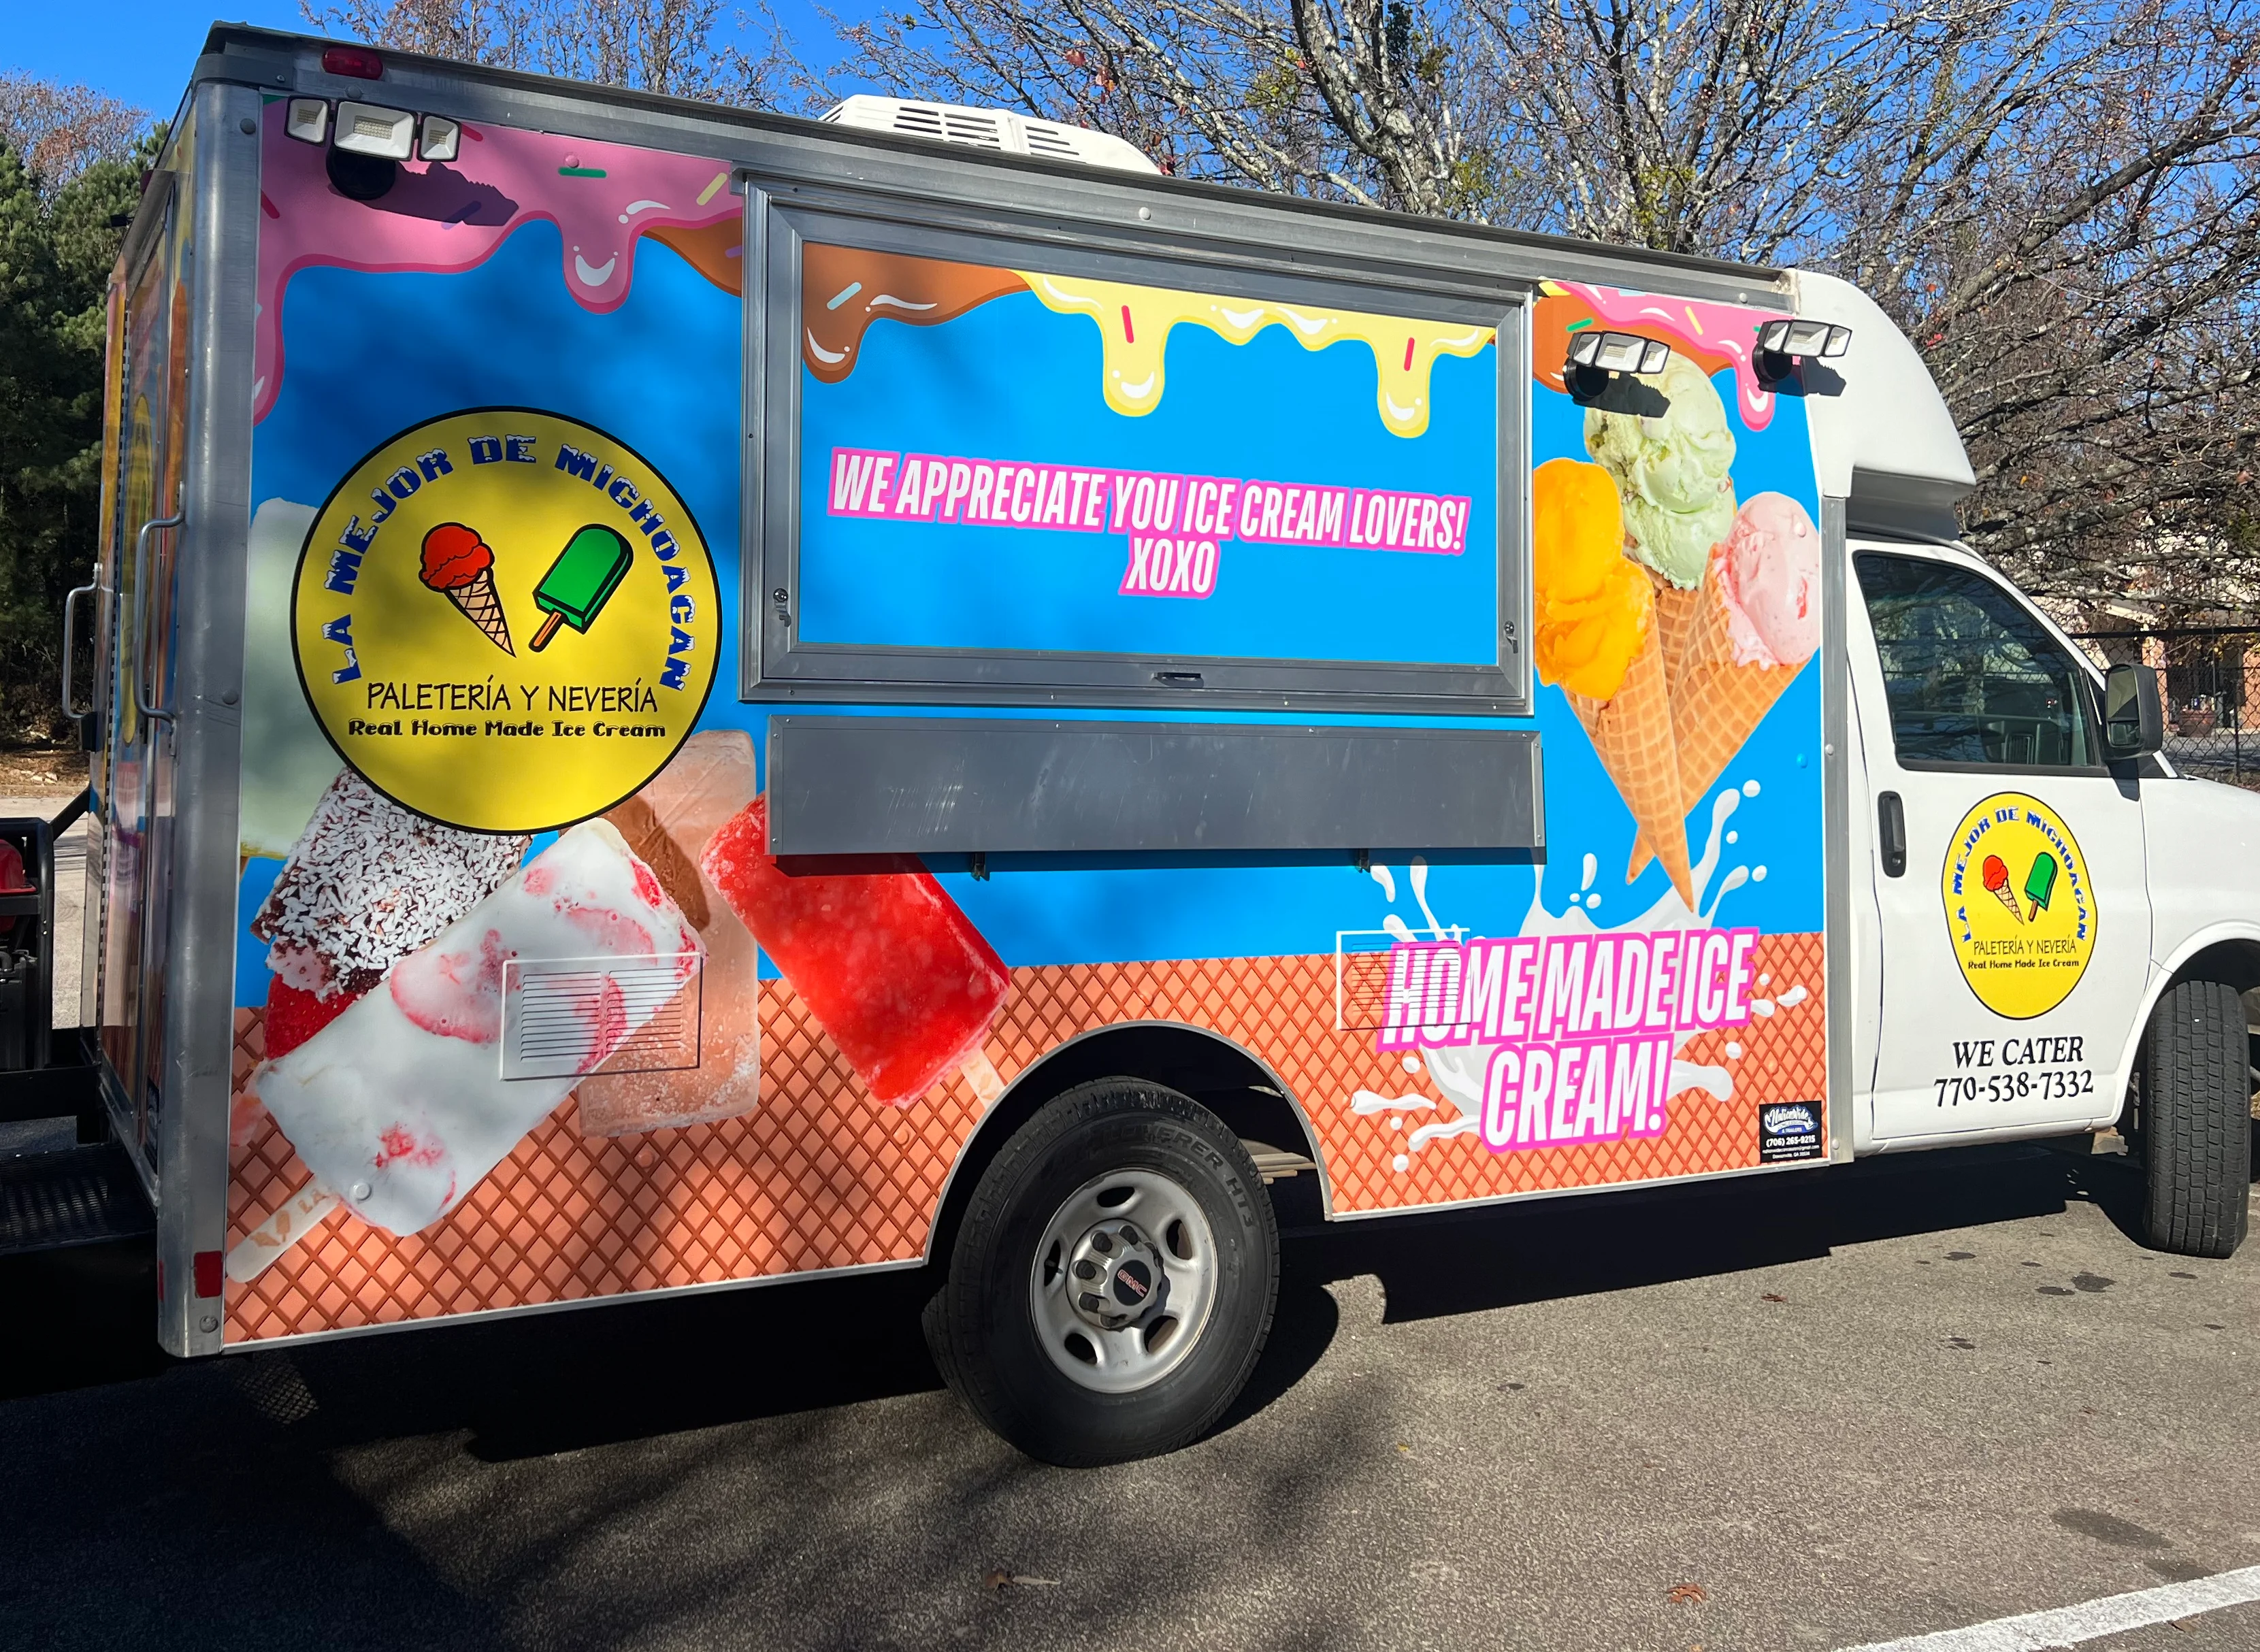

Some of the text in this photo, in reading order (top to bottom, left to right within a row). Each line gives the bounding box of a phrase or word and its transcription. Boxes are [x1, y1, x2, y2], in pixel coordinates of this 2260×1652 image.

[833, 454, 1467, 550] WE APPRECIATE YOU ICE CREAM LOVERS!
[322, 435, 695, 691] LA MEJOR DE MICHOACAN
[1126, 538, 1215, 593] XOXO
[367, 674, 658, 712] PALETERÍA Y NEVERÍA
[348, 718, 666, 737] Real Home Made Ice Cream
[1952, 806, 2089, 943] LA MEJOR DE MICHOACAN
[1974, 934, 2077, 955] PALETERÍA Y NEVERÍA
[1968, 958, 2080, 970] Real Home Made Ice Cream
[1382, 934, 1754, 1044] HOME MADE ICE
[1953, 1036, 2083, 1068] WE CATER
[1484, 1040, 1667, 1146] CREAM!
[1934, 1069, 2094, 1107] 770-538-7332
[1117, 1269, 1147, 1298] GMC
